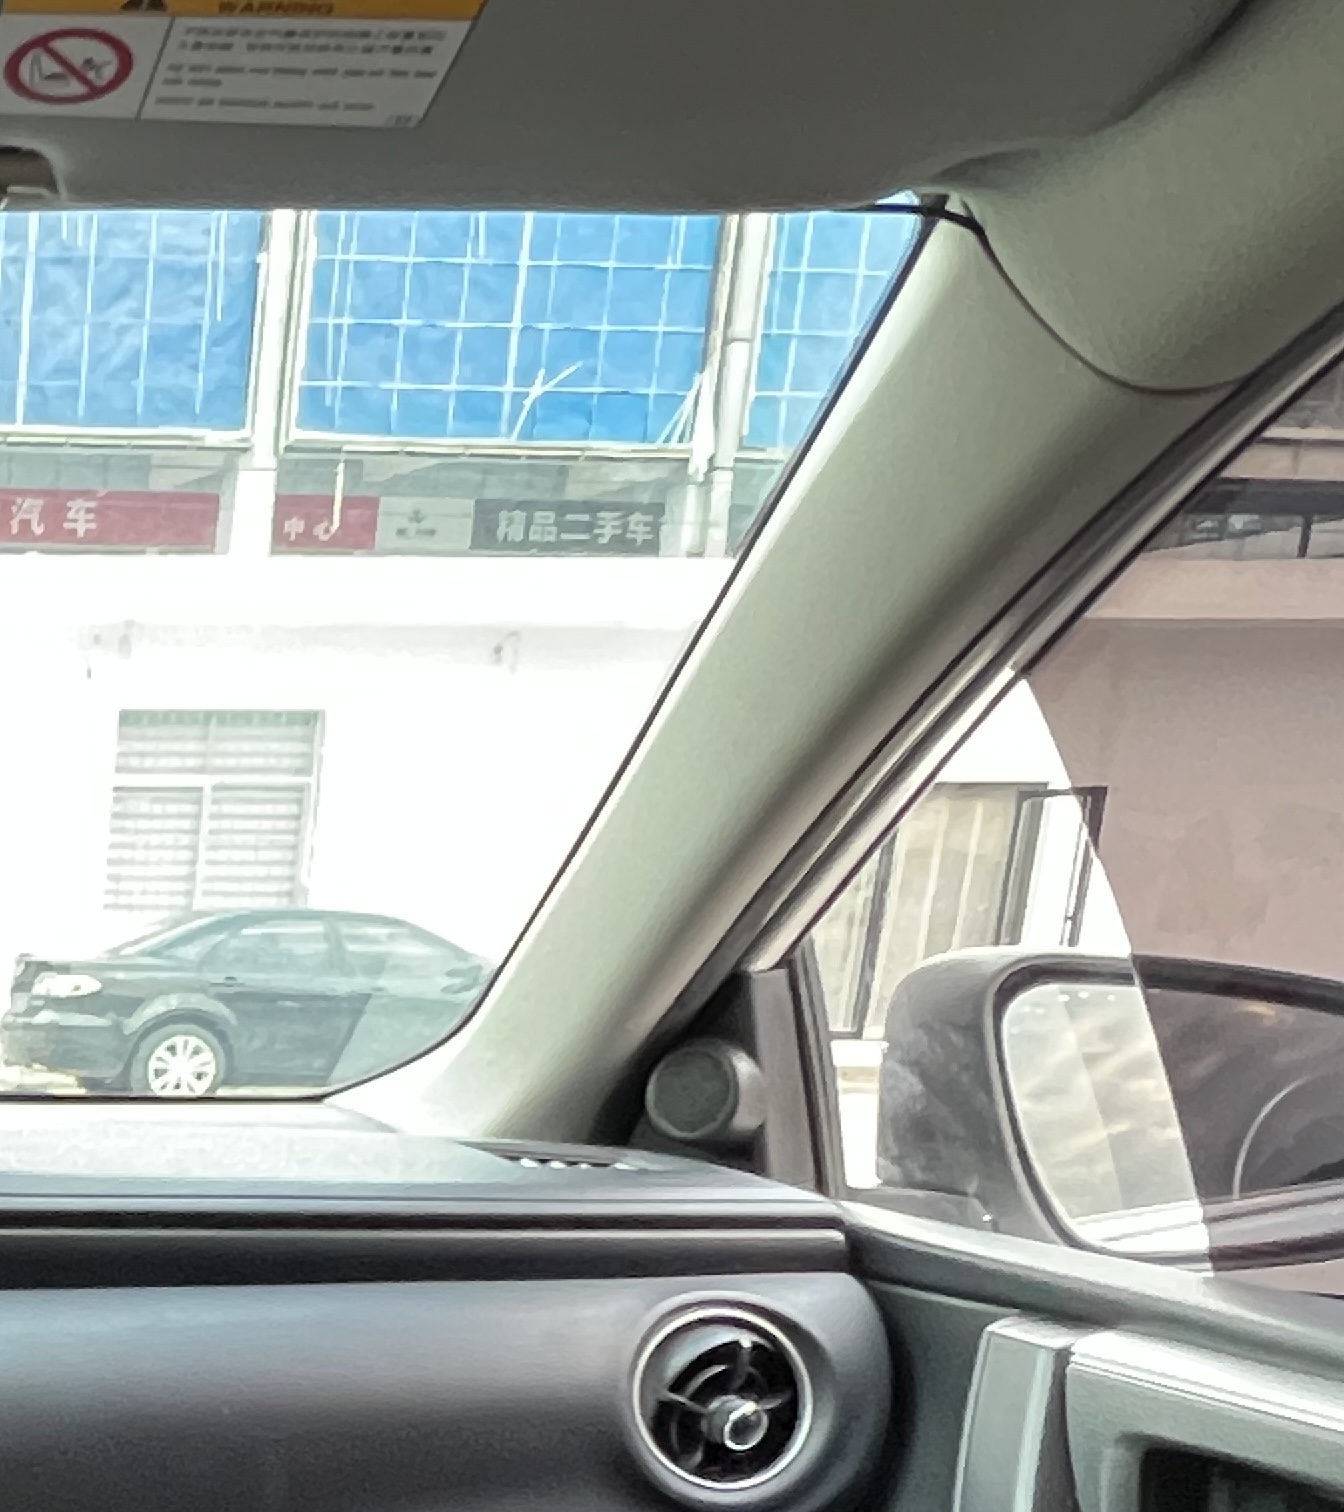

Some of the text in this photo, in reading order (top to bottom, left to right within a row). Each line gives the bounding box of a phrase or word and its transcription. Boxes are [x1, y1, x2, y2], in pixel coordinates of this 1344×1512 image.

[496, 509, 655, 545] 精品二手车
